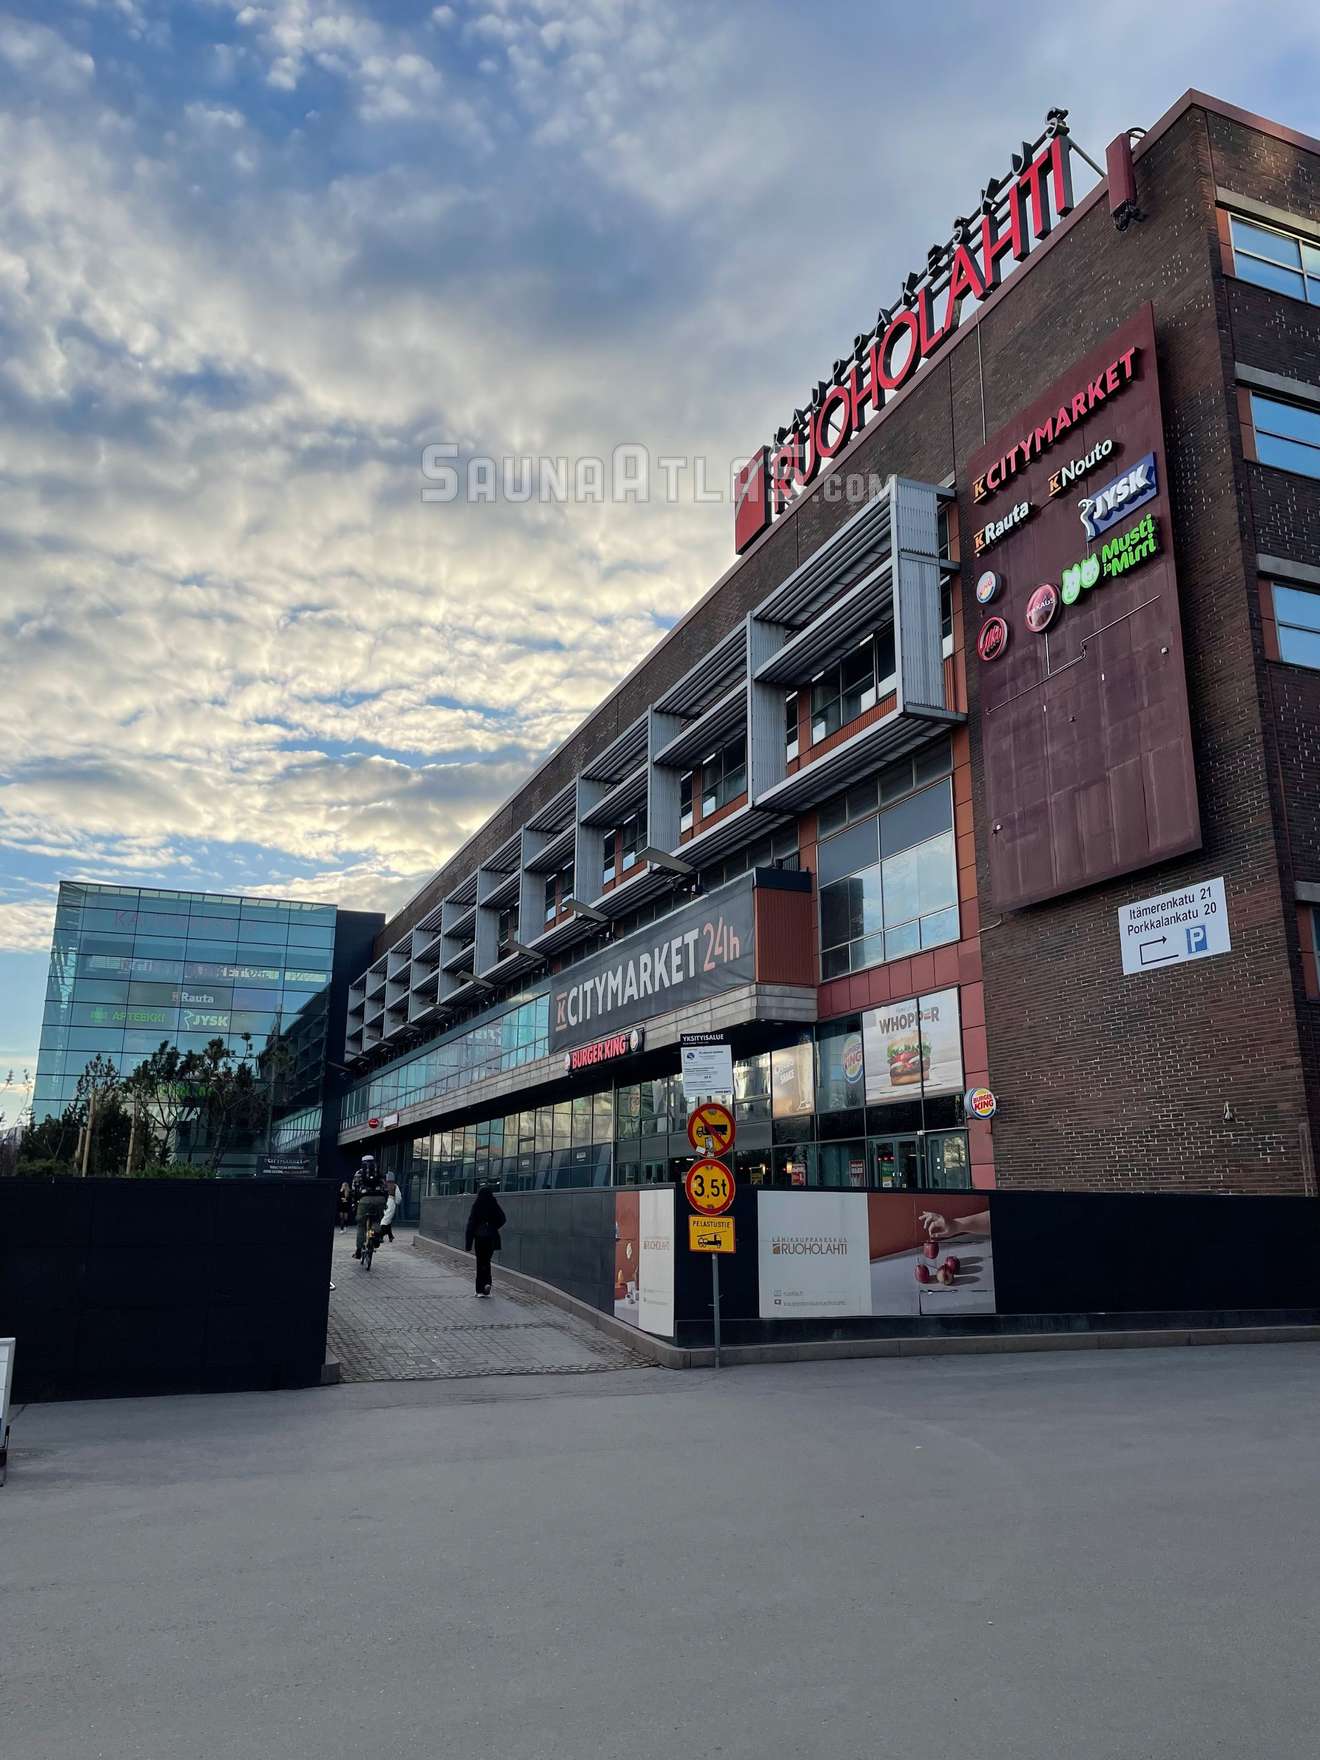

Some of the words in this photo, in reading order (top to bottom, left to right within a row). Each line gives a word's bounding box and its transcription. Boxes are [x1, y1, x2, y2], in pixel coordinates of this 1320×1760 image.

[773, 135, 1073, 514] RUOHOLAHTI
[986, 347, 1136, 489] CITYMARKET
[1061, 440, 1113, 487] Nouto
[1093, 464, 1151, 520] JYSK
[985, 501, 1029, 545] Rauta
[1102, 513, 1155, 563] Musti
[1111, 533, 1156, 577] Mirri
[1127, 909, 1199, 936] Porkkalankatu
[1204, 902, 1217, 915] 20
[1129, 893, 1195, 920] Itämerenkatu
[1200, 886, 1212, 900] 21
[568, 928, 700, 1027] CITYMARKET
[703, 917, 740, 972] 24h
[181, 992, 214, 1004] Rauta
[193, 1016, 228, 1027] JYSK
[682, 1033, 725, 1042] YKSITYISALUE
[572, 1042, 603, 1069] BURGER
[604, 1034, 626, 1060] KING
[973, 1094, 992, 1104] BURGER
[974, 1099, 994, 1110] KING
[692, 1220, 730, 1229] PELASTUSTIE
[781, 1242, 848, 1255] RUOHOLAHTI
